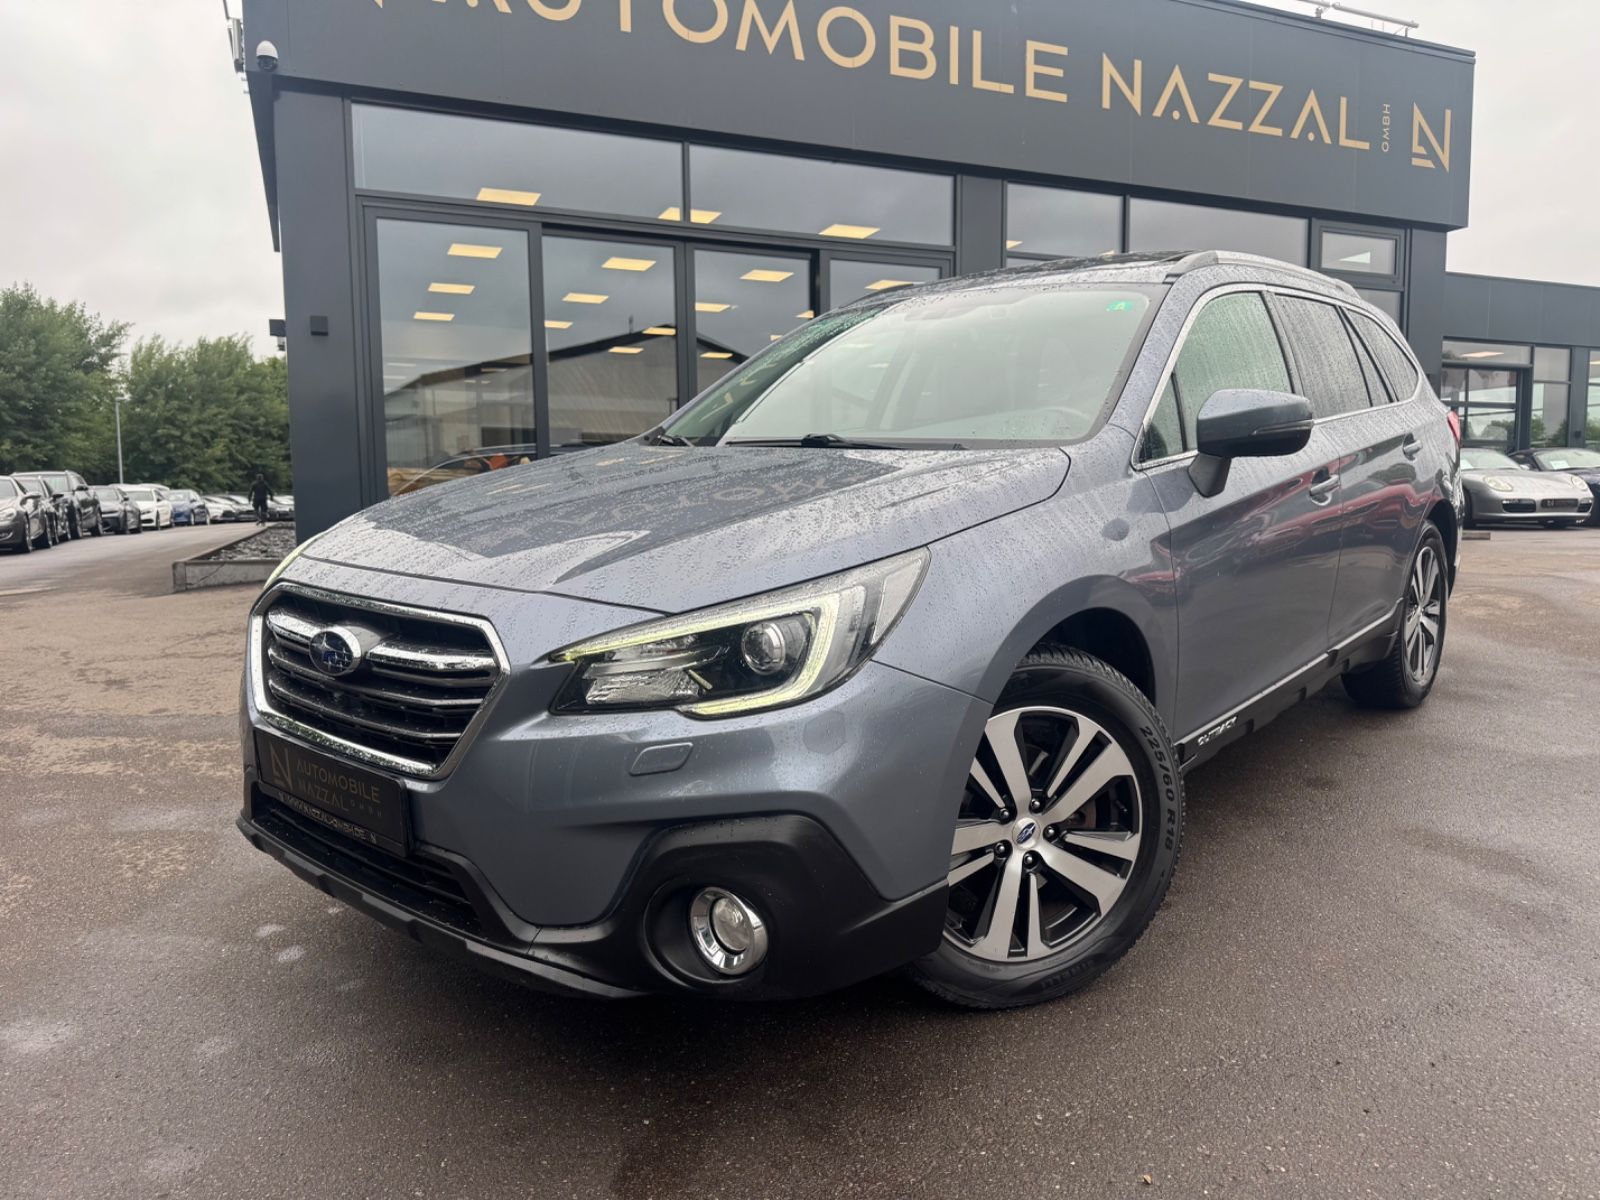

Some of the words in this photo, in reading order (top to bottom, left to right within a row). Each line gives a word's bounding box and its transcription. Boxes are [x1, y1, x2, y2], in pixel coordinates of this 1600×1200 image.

[433, 0, 1068, 102] OMOBILE
[1101, 52, 1370, 150] NAZZAL
[296, 758, 381, 803] AUTOMOBILE
[1139, 725, 1175, 802] 225/60
[1165, 808, 1176, 850] R18
